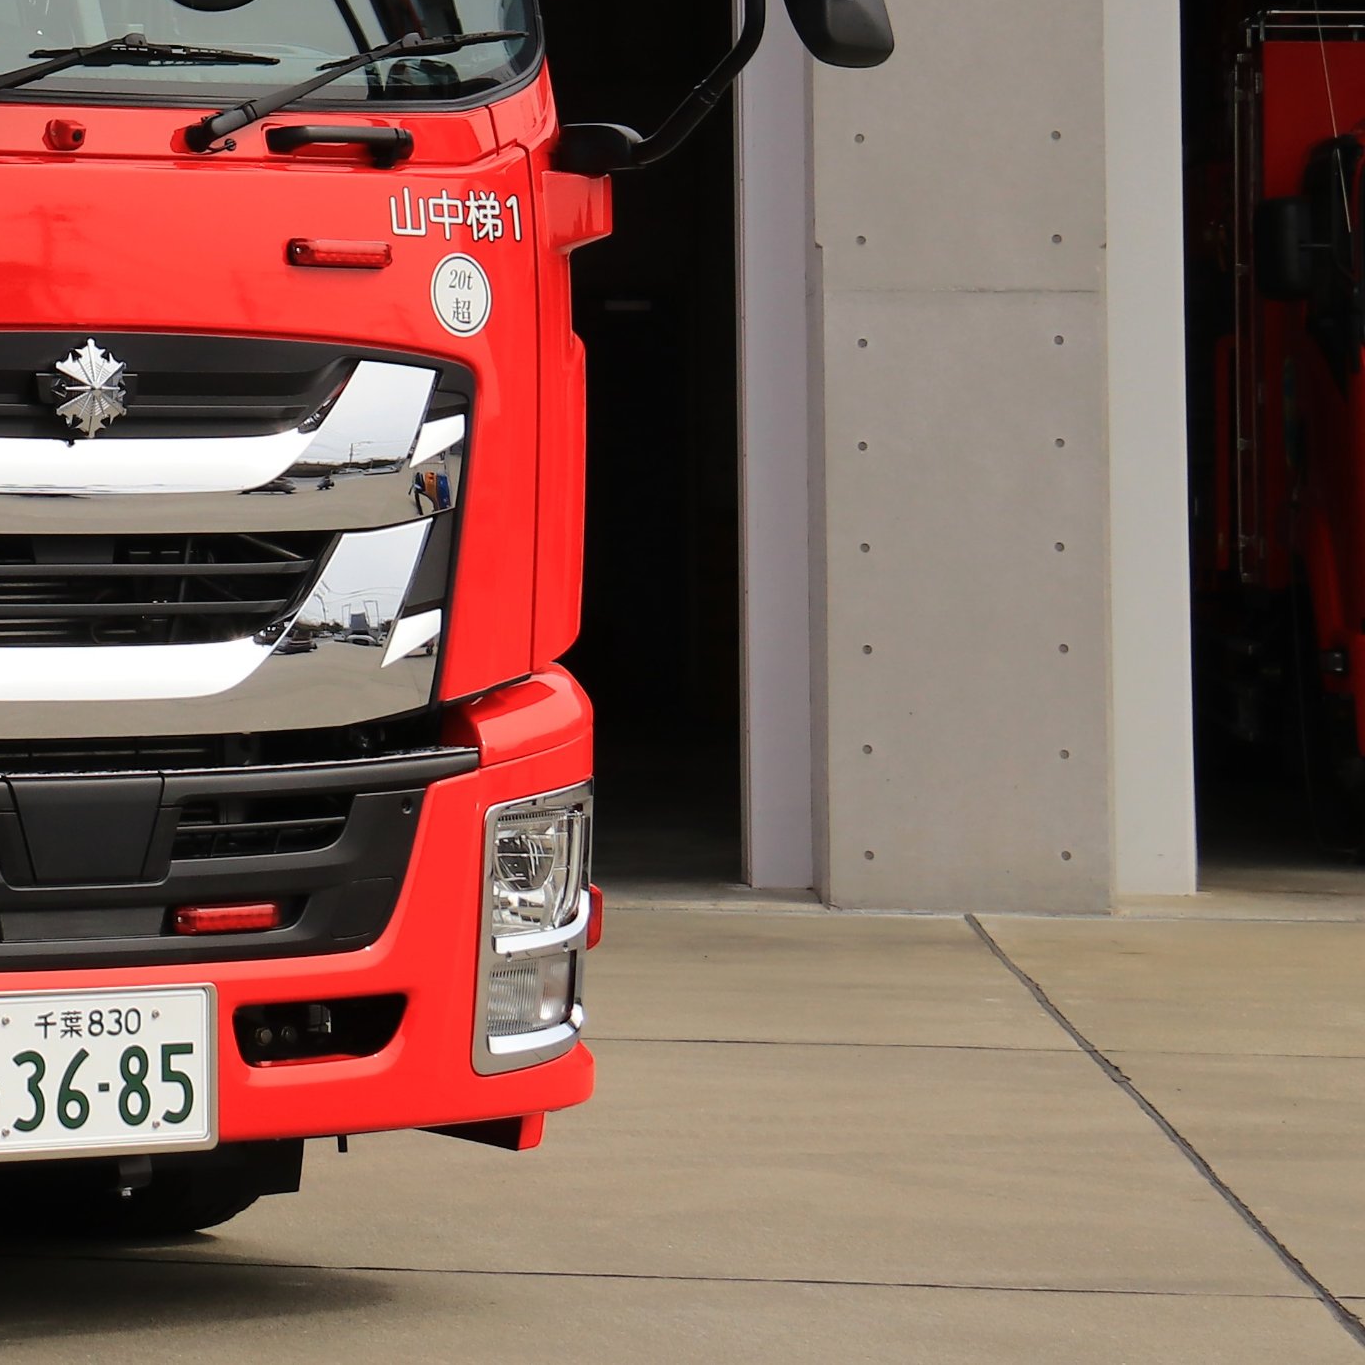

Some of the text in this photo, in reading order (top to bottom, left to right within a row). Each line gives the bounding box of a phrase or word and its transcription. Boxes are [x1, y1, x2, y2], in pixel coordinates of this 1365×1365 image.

[388, 185, 523, 243] 山中梯1
[448, 269, 474, 291] 20t
[451, 297, 472, 325] 超
[12, 1042, 195, 1133] 36-85
